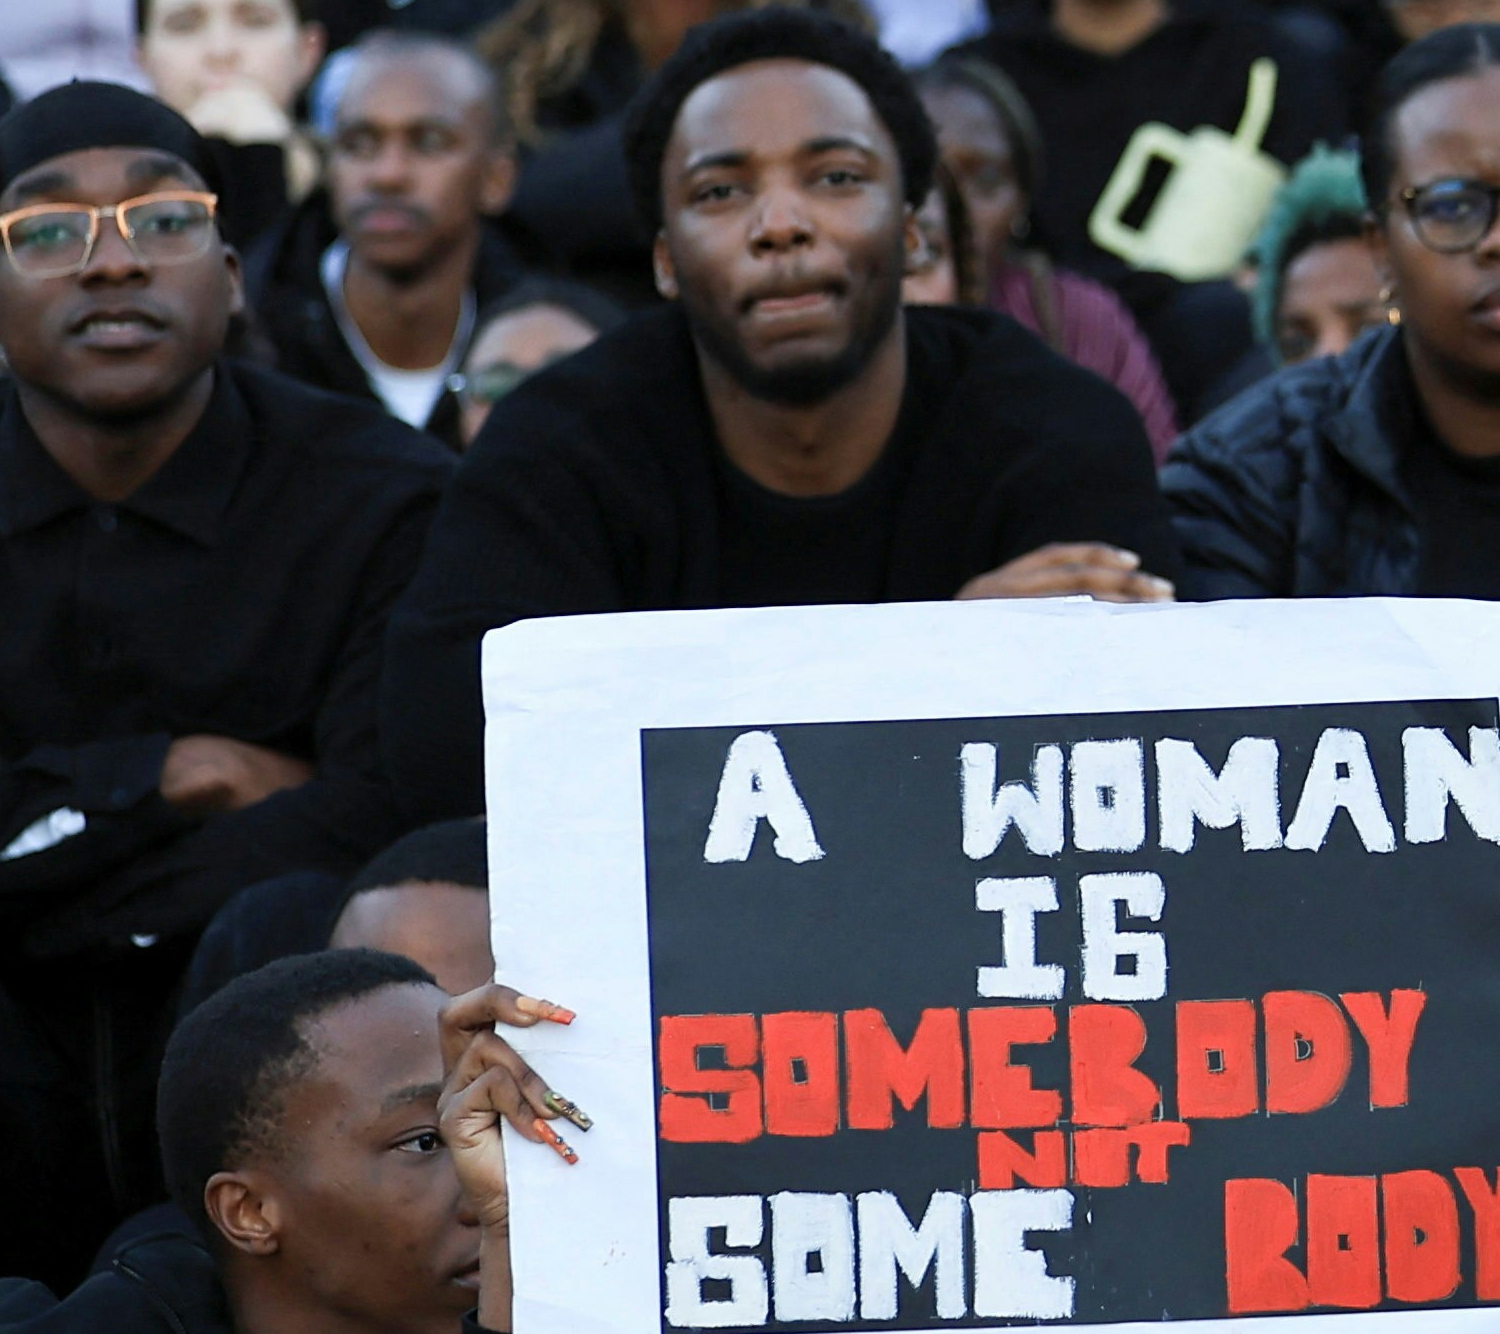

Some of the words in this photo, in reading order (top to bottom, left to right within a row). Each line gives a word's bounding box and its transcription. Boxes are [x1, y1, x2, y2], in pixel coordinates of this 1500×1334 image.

[703, 729, 826, 864] A
[659, 989, 1429, 1143] SOMEBODY
[977, 1121, 1192, 1189] NOT
[664, 1188, 1076, 1328] SOME
